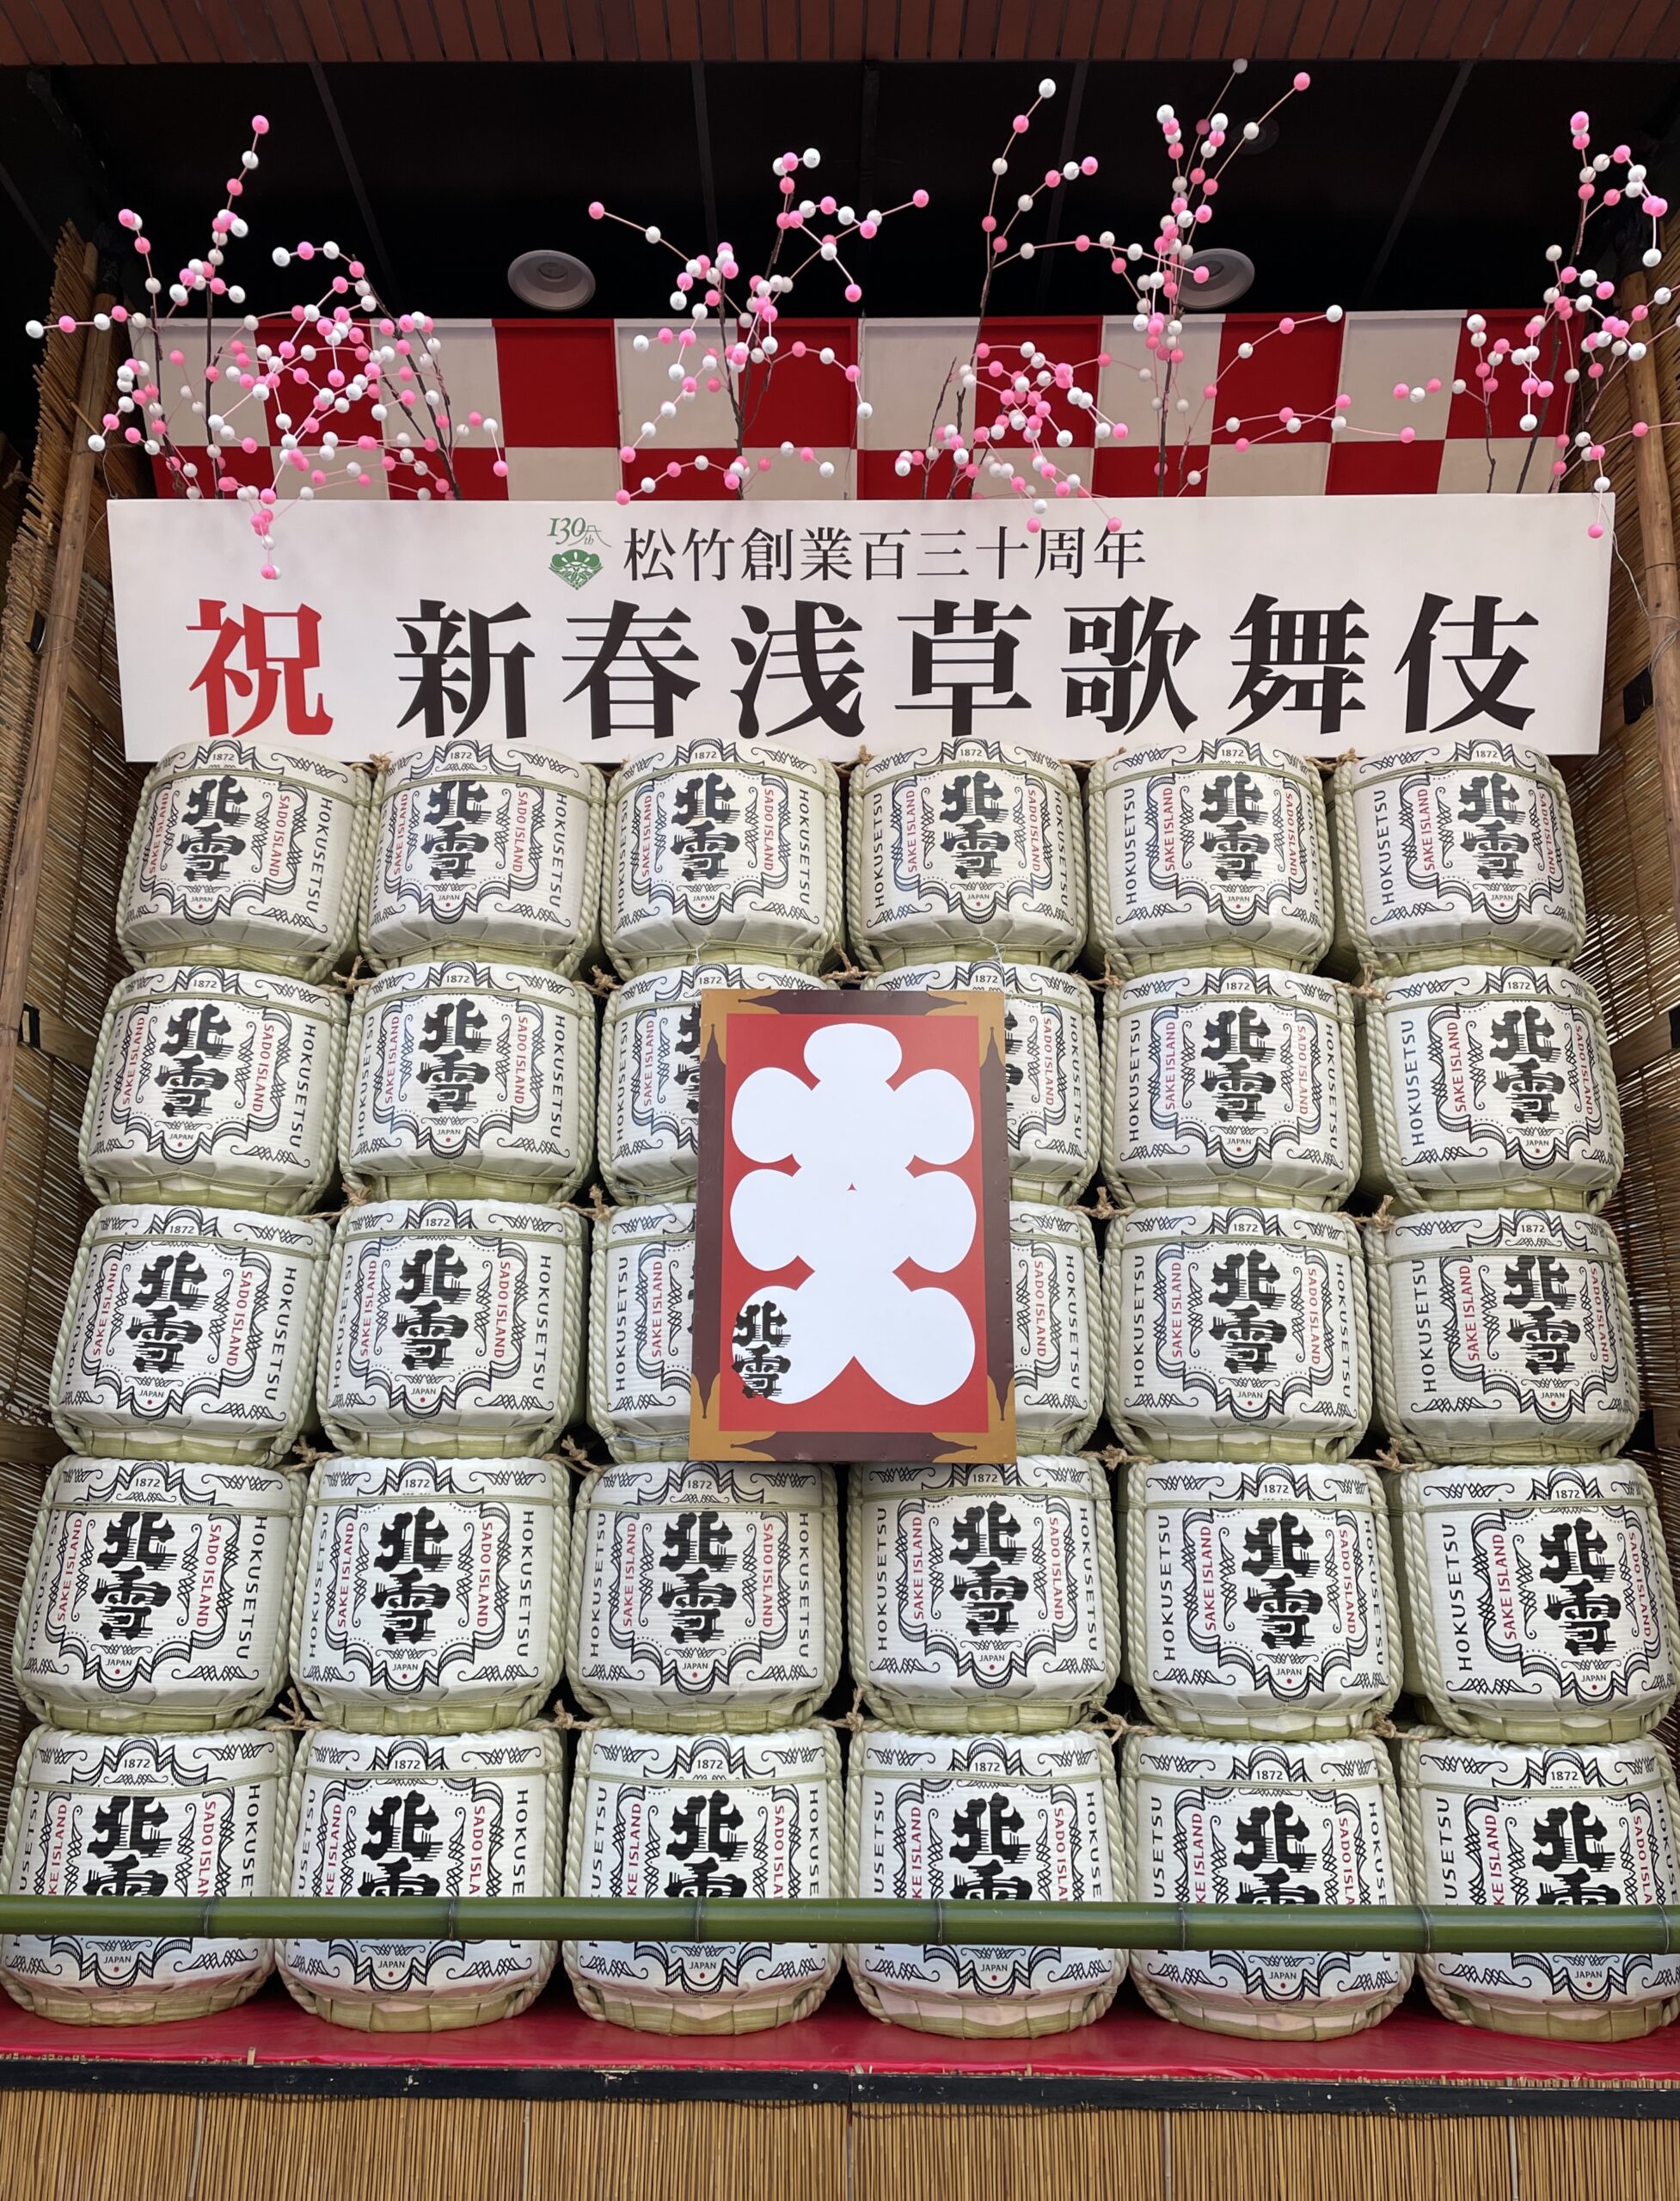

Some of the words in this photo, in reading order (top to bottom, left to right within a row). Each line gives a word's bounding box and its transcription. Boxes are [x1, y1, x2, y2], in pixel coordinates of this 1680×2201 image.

[622, 525, 1146, 582] 松竹創業百三十周年
[186, 598, 334, 738] 祝
[392, 592, 1540, 739] 新春浅草歌舞伎
[212, 753, 235, 762] 1872
[449, 751, 473, 760] 1872
[694, 751, 717, 760] 1872
[959, 748, 983, 757] 1872
[1220, 749, 1245, 757] 1872
[1475, 750, 1499, 758] 1872
[177, 775, 250, 882] 北雪
[275, 794, 291, 828] SADO
[397, 794, 408, 839] ISLAND
[642, 794, 653, 841] ISLAND
[670, 772, 741, 880] 北雪
[939, 770, 1010, 880] 北雪
[1027, 789, 1039, 822] SADO
[1199, 771, 1270, 880] 北雪
[1285, 792, 1295, 826] SADO
[1416, 788, 1432, 835] ISLAND
[1457, 772, 1530, 881] 北雪
[268, 830, 286, 877] ISLAND
[420, 780, 492, 881] 北雪
[549, 792, 567, 909] HOKUSETSU
[873, 793, 885, 910] HOKUSETSU
[1030, 825, 1042, 871] ISLAND
[1124, 788, 1137, 906] HOKUSETSU
[1287, 825, 1297, 875] ISLAND
[1373, 789, 1395, 906] HOKUSETSU
[305, 796, 334, 914] HOKUSETSU
[394, 841, 404, 876] SAKE
[617, 799, 628, 915] HOKUSETSU
[641, 843, 651, 876] SAKE
[1420, 839, 1436, 872] SAKE
[192, 979, 218, 989] 1872
[445, 974, 470, 984] 1872
[698, 976, 722, 985] 1872
[974, 974, 998, 984] 1872
[1225, 982, 1250, 991] 1872
[1506, 981, 1531, 990] 1872
[261, 1024, 275, 1060] SADO
[389, 1016, 401, 1065] ISLAND
[416, 998, 492, 1114] 北雪
[645, 1021, 655, 1067] ISLAND
[1043, 1017, 1054, 1053] SADO
[1297, 1026, 1307, 1062] SADO
[1445, 1021, 1462, 1072] ISLAND
[154, 1003, 233, 1119] 北雪
[549, 1014, 566, 1139] HOKUSETSU
[616, 1021, 628, 1143] HOKUSETSU
[1045, 1056, 1055, 1105] ISLAND
[1070, 1015, 1082, 1141] HOKUSETSU
[1128, 1019, 1141, 1143] HOKUSETSU
[1200, 1005, 1275, 1123] 北雪
[1401, 1020, 1426, 1147] HOKUSETSU
[1488, 1005, 1567, 1125] 北雪
[251, 1061, 271, 1113] ISLAND
[289, 1023, 317, 1149] HOKUSETSU
[383, 1070, 396, 1103] SAKE
[643, 1070, 654, 1105] SAKE
[1298, 1064, 1309, 1115] ISLAND
[1451, 1076, 1468, 1113] SAKE
[169, 1225, 195, 1235] 1872
[425, 1217, 451, 1228] 1872
[1232, 1223, 1259, 1233] 1872
[1520, 1224, 1546, 1234] 1872
[236, 1271, 254, 1310] SADO
[364, 1260, 377, 1314] ISLAND
[651, 1260, 663, 1315] ISLAND
[1033, 1260, 1045, 1300] SADO
[1308, 1268, 1318, 1308] SADO
[1456, 1265, 1476, 1319] ISLAND
[125, 1250, 210, 1374] 北雪
[391, 1243, 472, 1372] 北雪
[532, 1254, 552, 1391] HOKUSETSU
[615, 1256, 628, 1393] HOKUSETSU
[1034, 1303, 1047, 1357] ISLAND
[1065, 1254, 1081, 1390] HOKUSETSU
[1133, 1254, 1145, 1389] HOKUSETSU
[1208, 1248, 1288, 1375] 北雪
[1412, 1258, 1438, 1394] HOKUSETSU
[1503, 1255, 1582, 1376] 北雪
[225, 1311, 247, 1367] ISLAND
[264, 1266, 297, 1401] HOKUSETSU
[359, 1319, 372, 1356] SAKE
[650, 1319, 663, 1358] SAKE
[732, 1300, 792, 1399] 北雪
[1309, 1309, 1322, 1365] ISLAND
[1463, 1323, 1481, 1361] SAKE
[138, 1389, 165, 1399] JAPAN
[1236, 1390, 1263, 1399] JAPAN
[134, 1477, 161, 1488] 1872
[404, 1478, 431, 1488] 1872
[686, 1479, 713, 1490] 1872
[970, 1472, 1001, 1484] 1872
[1262, 1484, 1290, 1494] 1872
[1554, 1489, 1583, 1499] 1872
[205, 1523, 224, 1566] SADO
[341, 1521, 356, 1581] ISLAND
[624, 1521, 638, 1580] ISLAND
[1048, 1517, 1061, 1559] SADO
[1339, 1529, 1351, 1572] SADO
[91, 1511, 178, 1640] 北雪
[370, 1505, 454, 1645] 北雪
[516, 1510, 535, 1658] HOKUSETSU
[590, 1512, 606, 1658] HOKUSETSU
[657, 1511, 738, 1644] 北雪
[876, 1506, 888, 1652] HOKUSETSU
[949, 1501, 1029, 1637] 北雪
[1242, 1511, 1323, 1651] 北雪
[1490, 1533, 1512, 1593] ISLAND
[194, 1568, 218, 1628] ISLAND
[236, 1516, 266, 1660] HOKUSETSU
[336, 1585, 350, 1628] SAKE
[622, 1585, 635, 1627] SAKE
[1051, 1561, 1065, 1621] ISLAND
[1157, 1515, 1176, 1661] HOKUSETSU
[1342, 1575, 1358, 1634] ISLAND
[1441, 1523, 1474, 1671] HOKUSETSU
[1540, 1517, 1622, 1656] 北雪
[1499, 1598, 1518, 1640] SAKE
[105, 1658, 133, 1667] JAPAN
[391, 1663, 419, 1671] JAPAN
[682, 1662, 708, 1671] JAPAN
[978, 1654, 1005, 1663] JAPAN
[1275, 1668, 1303, 1677] JAPAN
[1580, 1674, 1607, 1683] JAPAN
[123, 1758, 150, 1769] 1872
[393, 1759, 421, 1770] 1872
[696, 1759, 724, 1770] 1872
[973, 1762, 1001, 1773] 1872
[1255, 1769, 1284, 1781] 1872
[1549, 1770, 1579, 1781] 1872
[102, 1955, 132, 1965] JAPAN
[377, 1959, 406, 1969] JAPAN
[688, 1961, 717, 1971] JAPAN
[979, 1963, 1009, 1972] JAPAN
[1268, 1971, 1297, 1980] JAPAN
[1574, 1970, 1603, 1979] JAPAN
